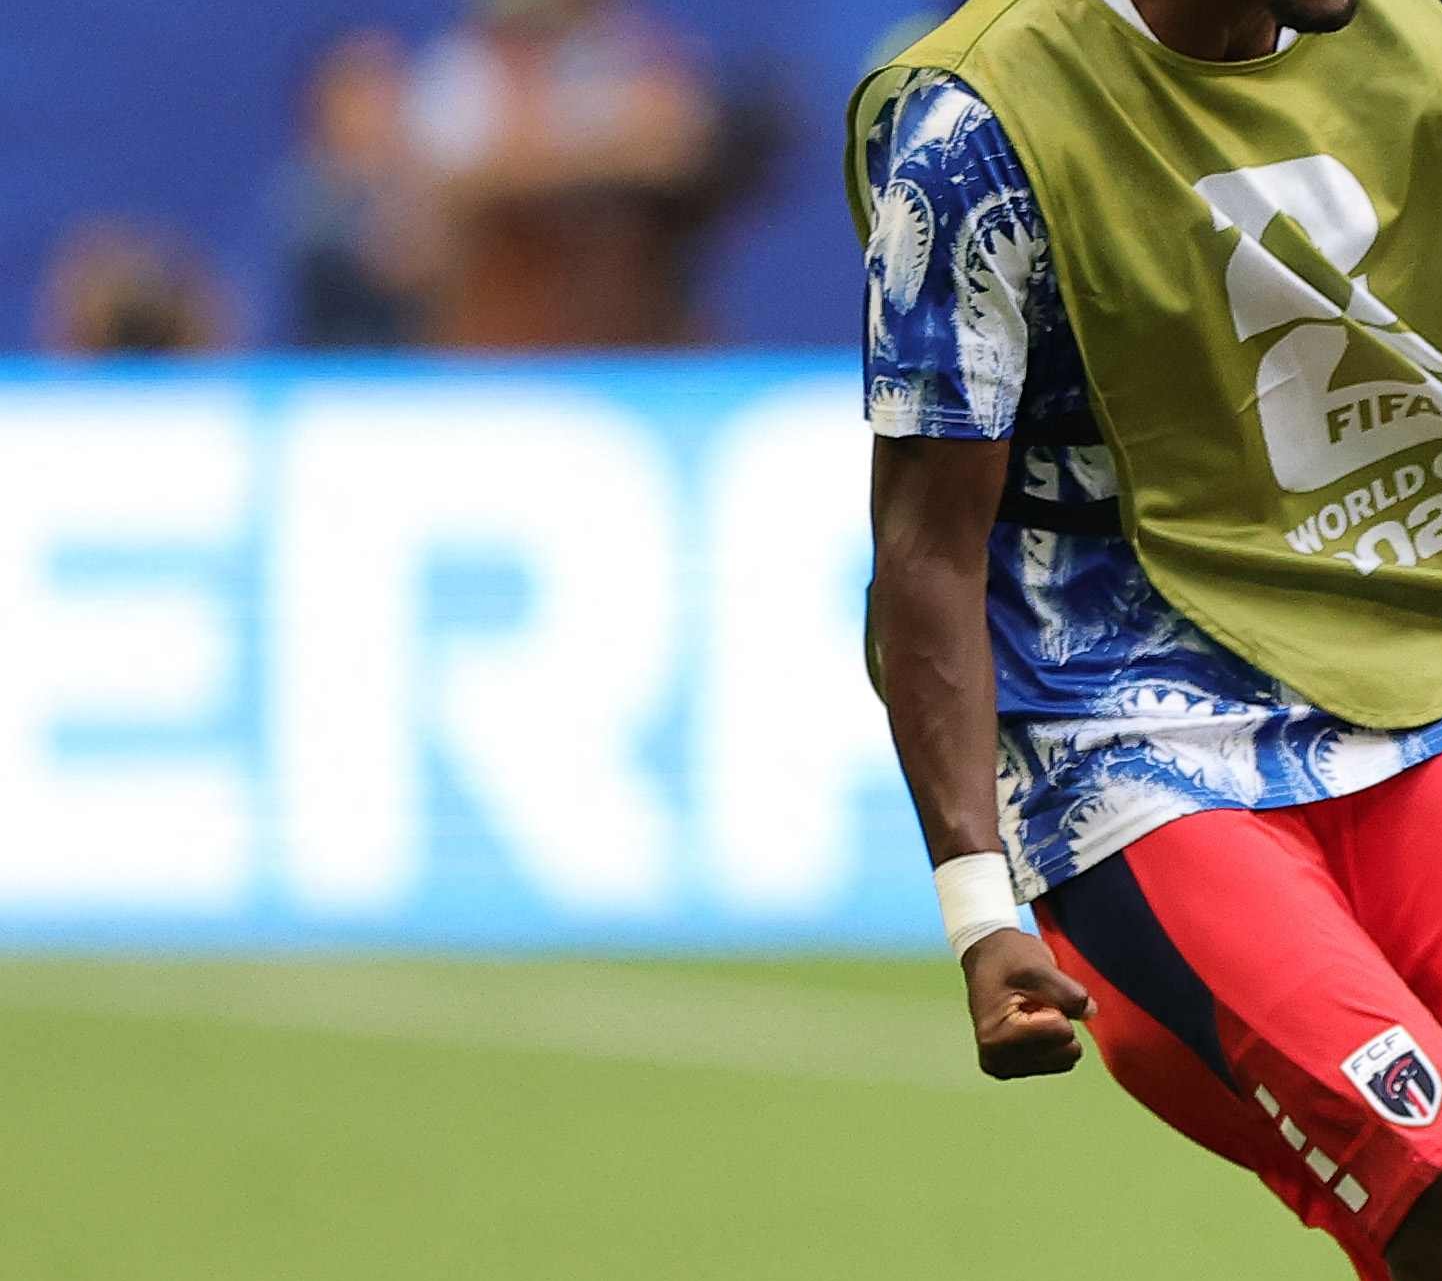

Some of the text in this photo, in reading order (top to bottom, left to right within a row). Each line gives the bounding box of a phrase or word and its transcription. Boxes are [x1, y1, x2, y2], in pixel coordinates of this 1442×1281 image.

[1327, 394, 1442, 445] FIFA
[1285, 464, 1425, 555] WORLD
[1351, 1031, 1401, 1077] FCF
